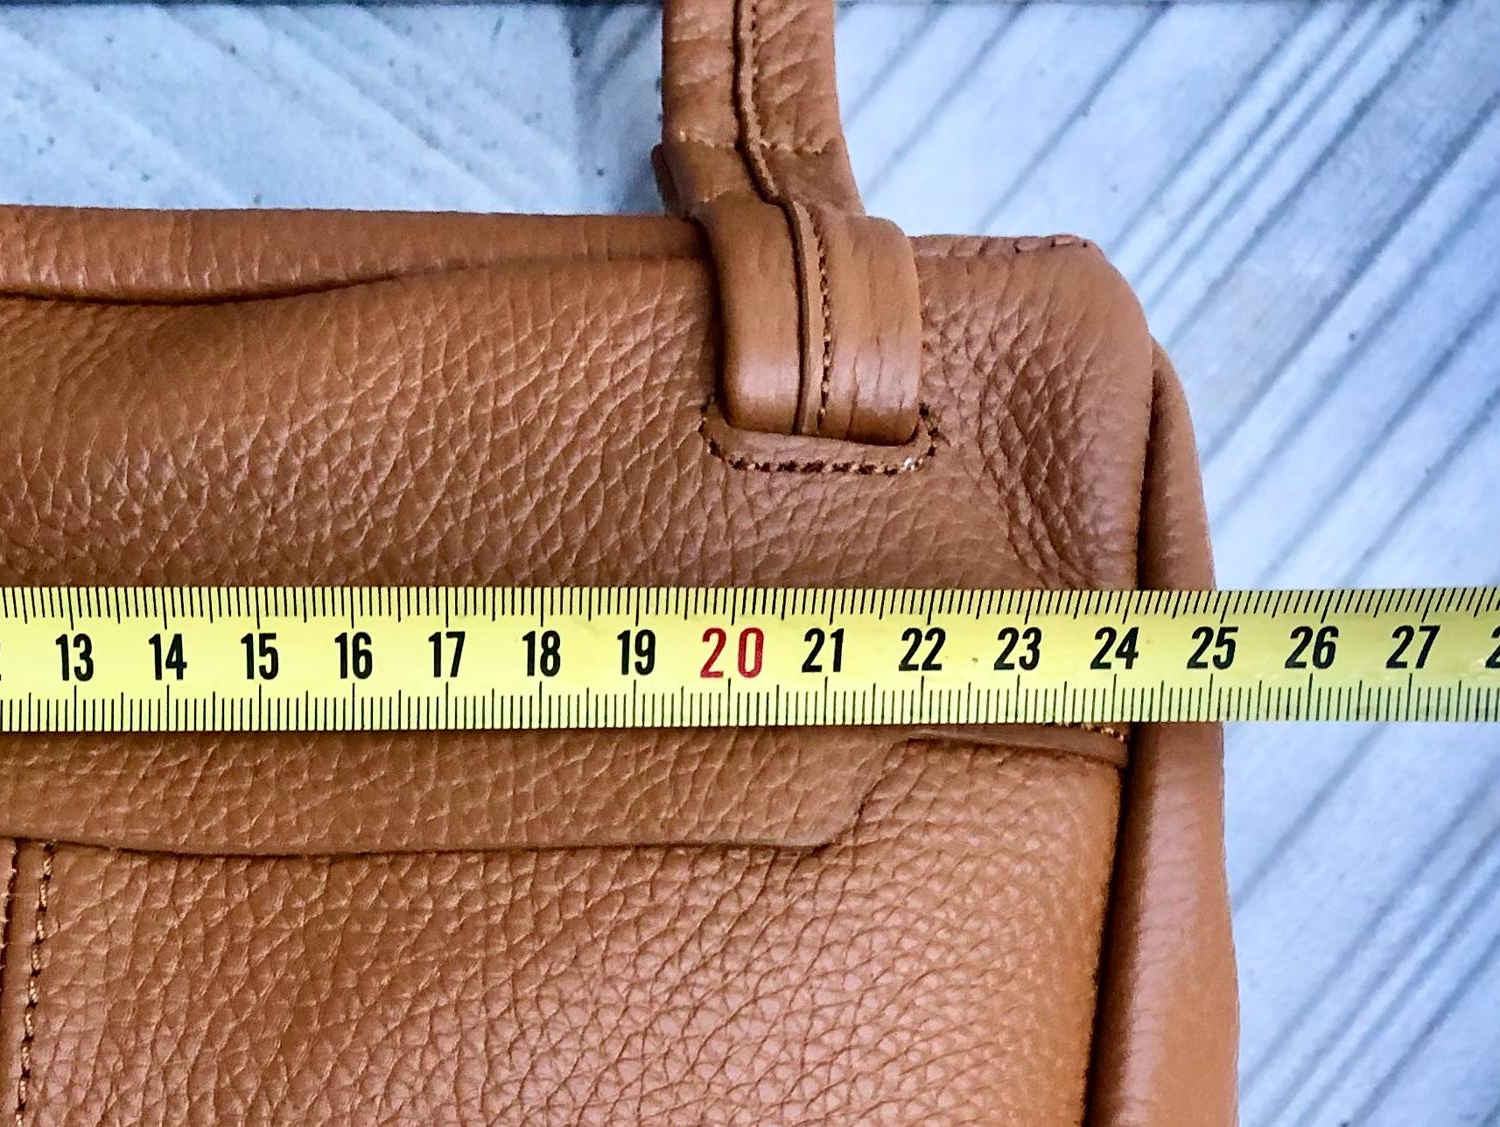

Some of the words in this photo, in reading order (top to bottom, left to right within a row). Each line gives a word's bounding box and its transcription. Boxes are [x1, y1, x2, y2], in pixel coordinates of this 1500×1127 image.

[55, 633, 94, 682] 13
[148, 633, 188, 681] 14
[240, 632, 279, 681] 15
[334, 631, 373, 680] 16
[428, 630, 466, 678] 17
[522, 630, 561, 677] 18
[616, 628, 656, 676] 19
[699, 626, 765, 679] 20
[801, 627, 845, 673] 21
[898, 627, 946, 672] 22
[993, 626, 1042, 671] 23
[1089, 626, 1140, 670] 24
[1186, 626, 1239, 670] 25
[1284, 625, 1340, 670] 26
[1385, 624, 1441, 669] 27
